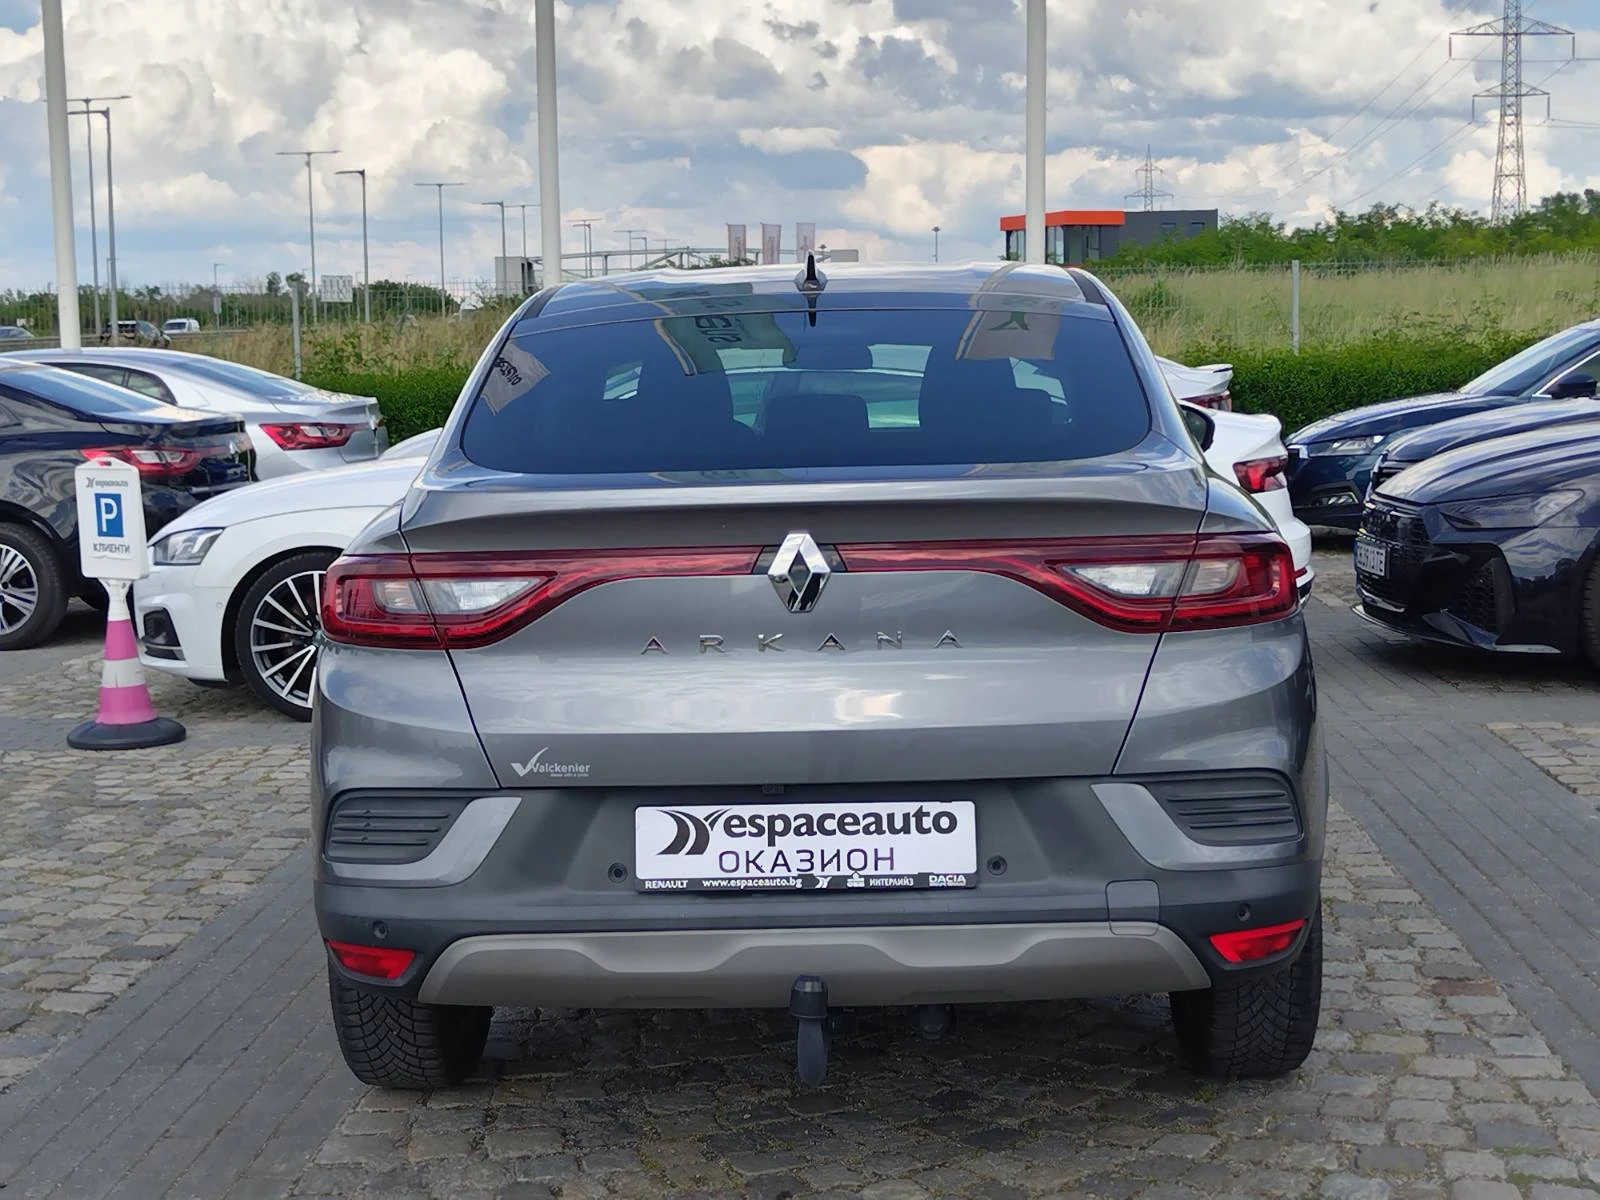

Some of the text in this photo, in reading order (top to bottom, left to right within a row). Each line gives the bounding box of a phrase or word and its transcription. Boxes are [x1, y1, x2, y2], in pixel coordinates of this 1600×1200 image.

[100, 497, 118, 533] P
[93, 543, 130, 554] КЛИЕНТИ
[640, 630, 963, 655] ARKANA
[723, 805, 958, 847] espaceauto
[718, 847, 895, 874] ОКАЗИОН
[644, 880, 689, 889] RENAULT
[702, 876, 803, 889] www.espaceauto.bg
[928, 875, 967, 885] DACIA
